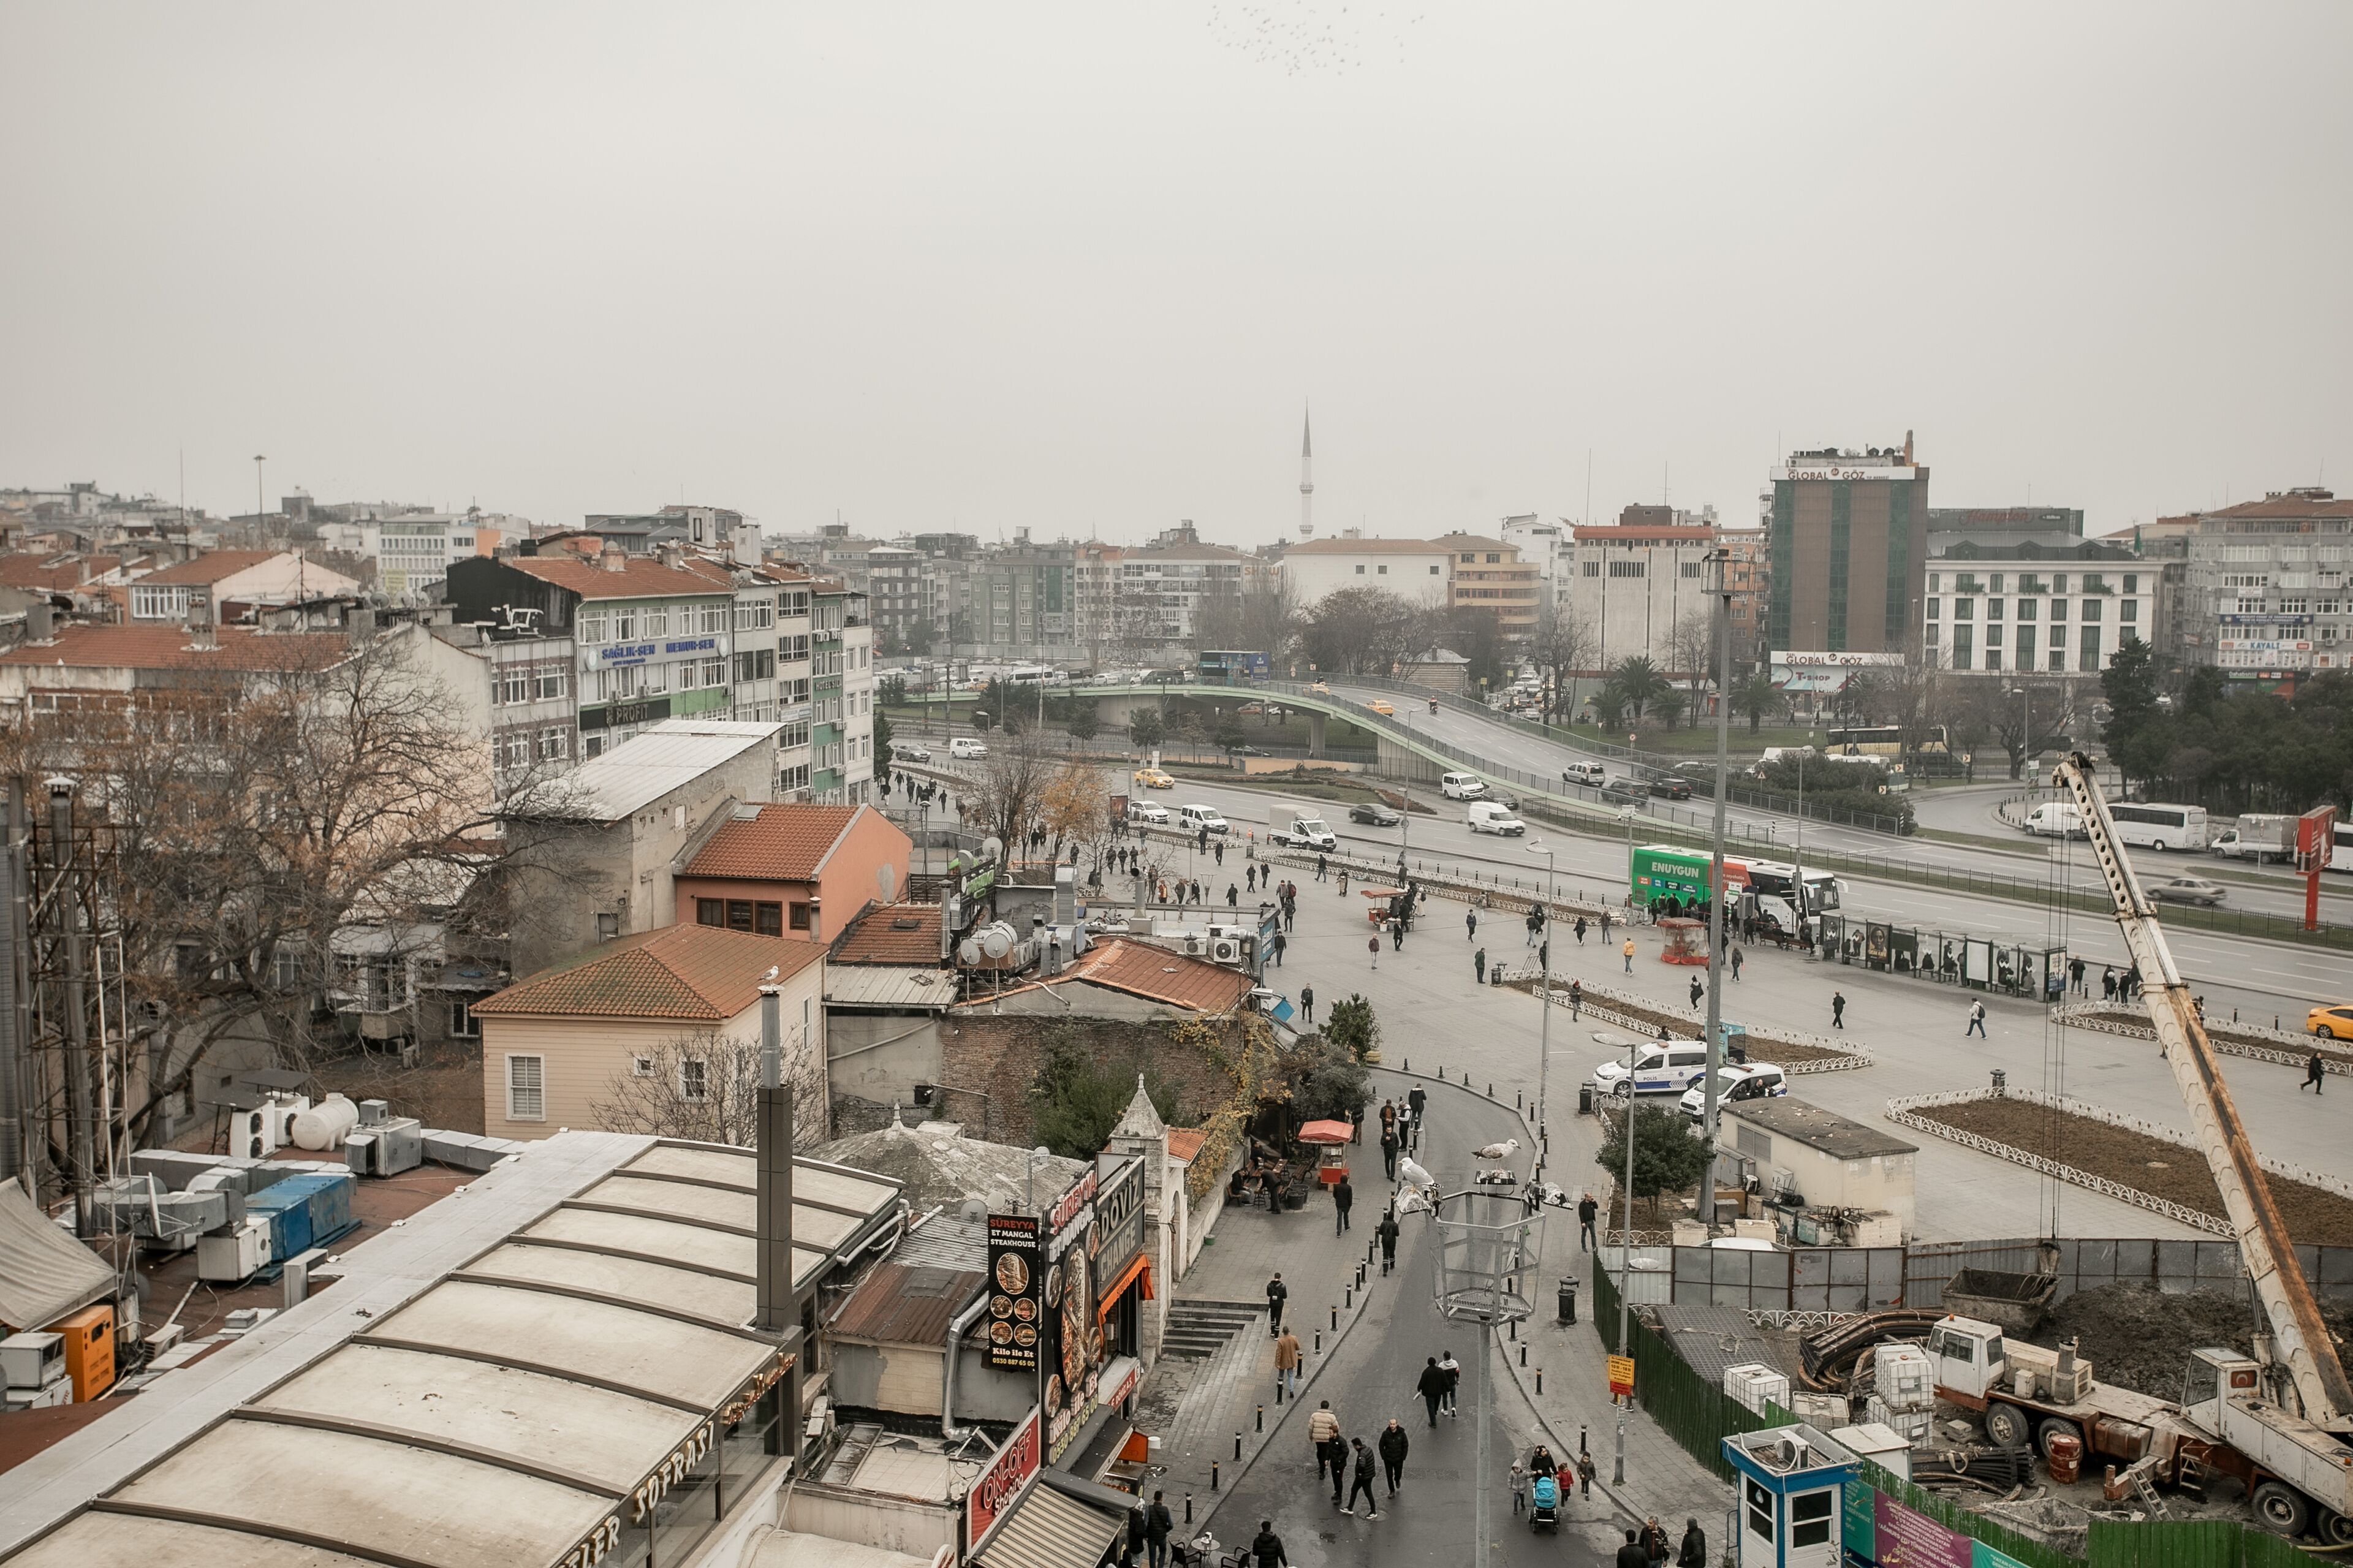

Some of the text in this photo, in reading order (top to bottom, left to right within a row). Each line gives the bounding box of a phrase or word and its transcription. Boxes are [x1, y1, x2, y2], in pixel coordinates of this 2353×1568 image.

[1843, 469, 1865, 480] GÖZ
[1959, 509, 2034, 525] Hampton
[602, 638, 714, 660] SAĞLIK-SEN MEMUR-SEN
[1786, 656, 1826, 665] GLOBAL
[1840, 655, 1863, 665] GÖZ
[616, 704, 649, 724] PROFIT
[1651, 862, 1699, 878] ENUYGUN
[1051, 1171, 1096, 1235] SÜREYYA
[1102, 1175, 1140, 1240] DÖVİZ
[990, 1218, 1035, 1230] SÜREYYA
[1002, 1230, 1033, 1239] MANGAL
[990, 1239, 1036, 1248] STEAKHOUSE
[1049, 1235, 1061, 1262] ET
[1101, 1221, 1135, 1281] CHANGE
[1115, 1387, 1126, 1404] DÖVİZ
[1050, 1371, 1098, 1444] Kilo ile Et
[1051, 1393, 1098, 1464] 0530 887 65 00
[635, 1420, 714, 1524] SOFRASI
[983, 1428, 1032, 1510] ON-OFF
[994, 1472, 1024, 1517] Shoping
